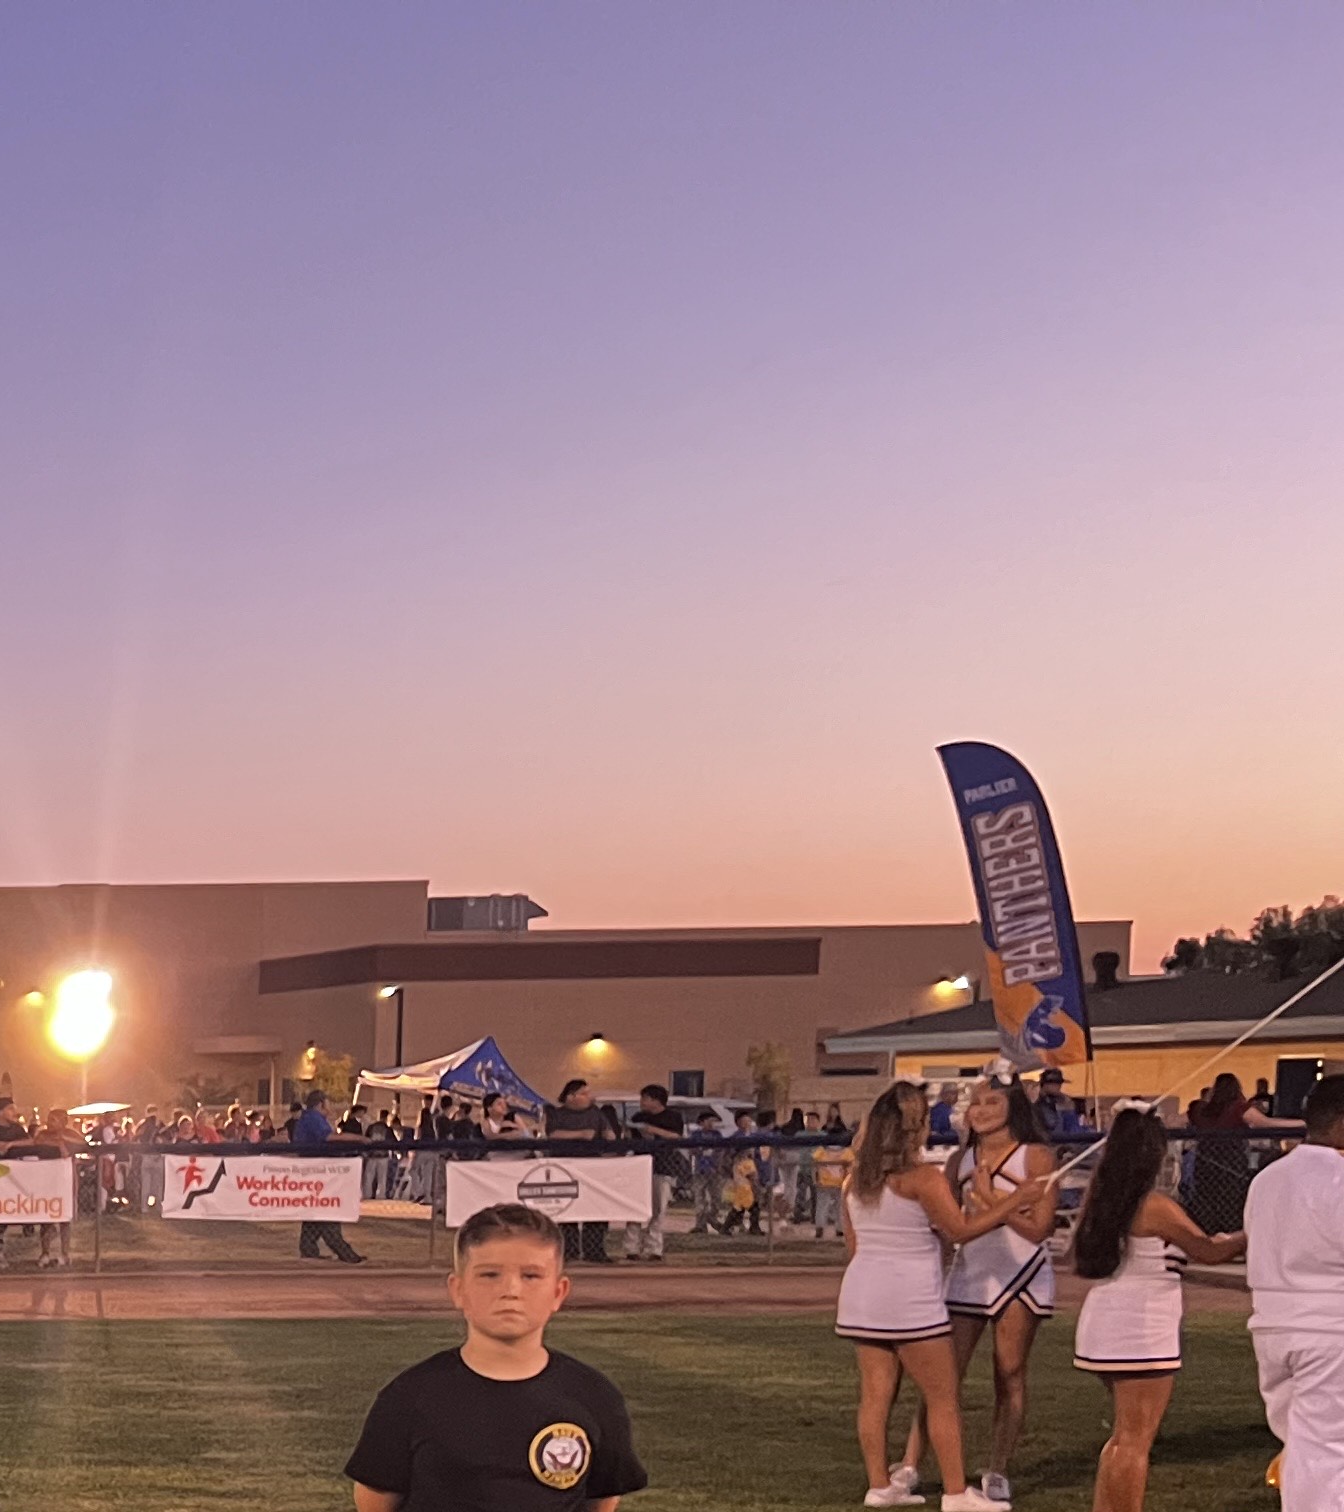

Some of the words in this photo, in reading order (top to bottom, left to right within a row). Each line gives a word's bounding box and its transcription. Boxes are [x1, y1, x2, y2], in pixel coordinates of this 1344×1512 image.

[974, 803, 1062, 986] PANTHERS
[236, 1175, 324, 1192] Workforce
[248, 1192, 341, 1208] Connection
